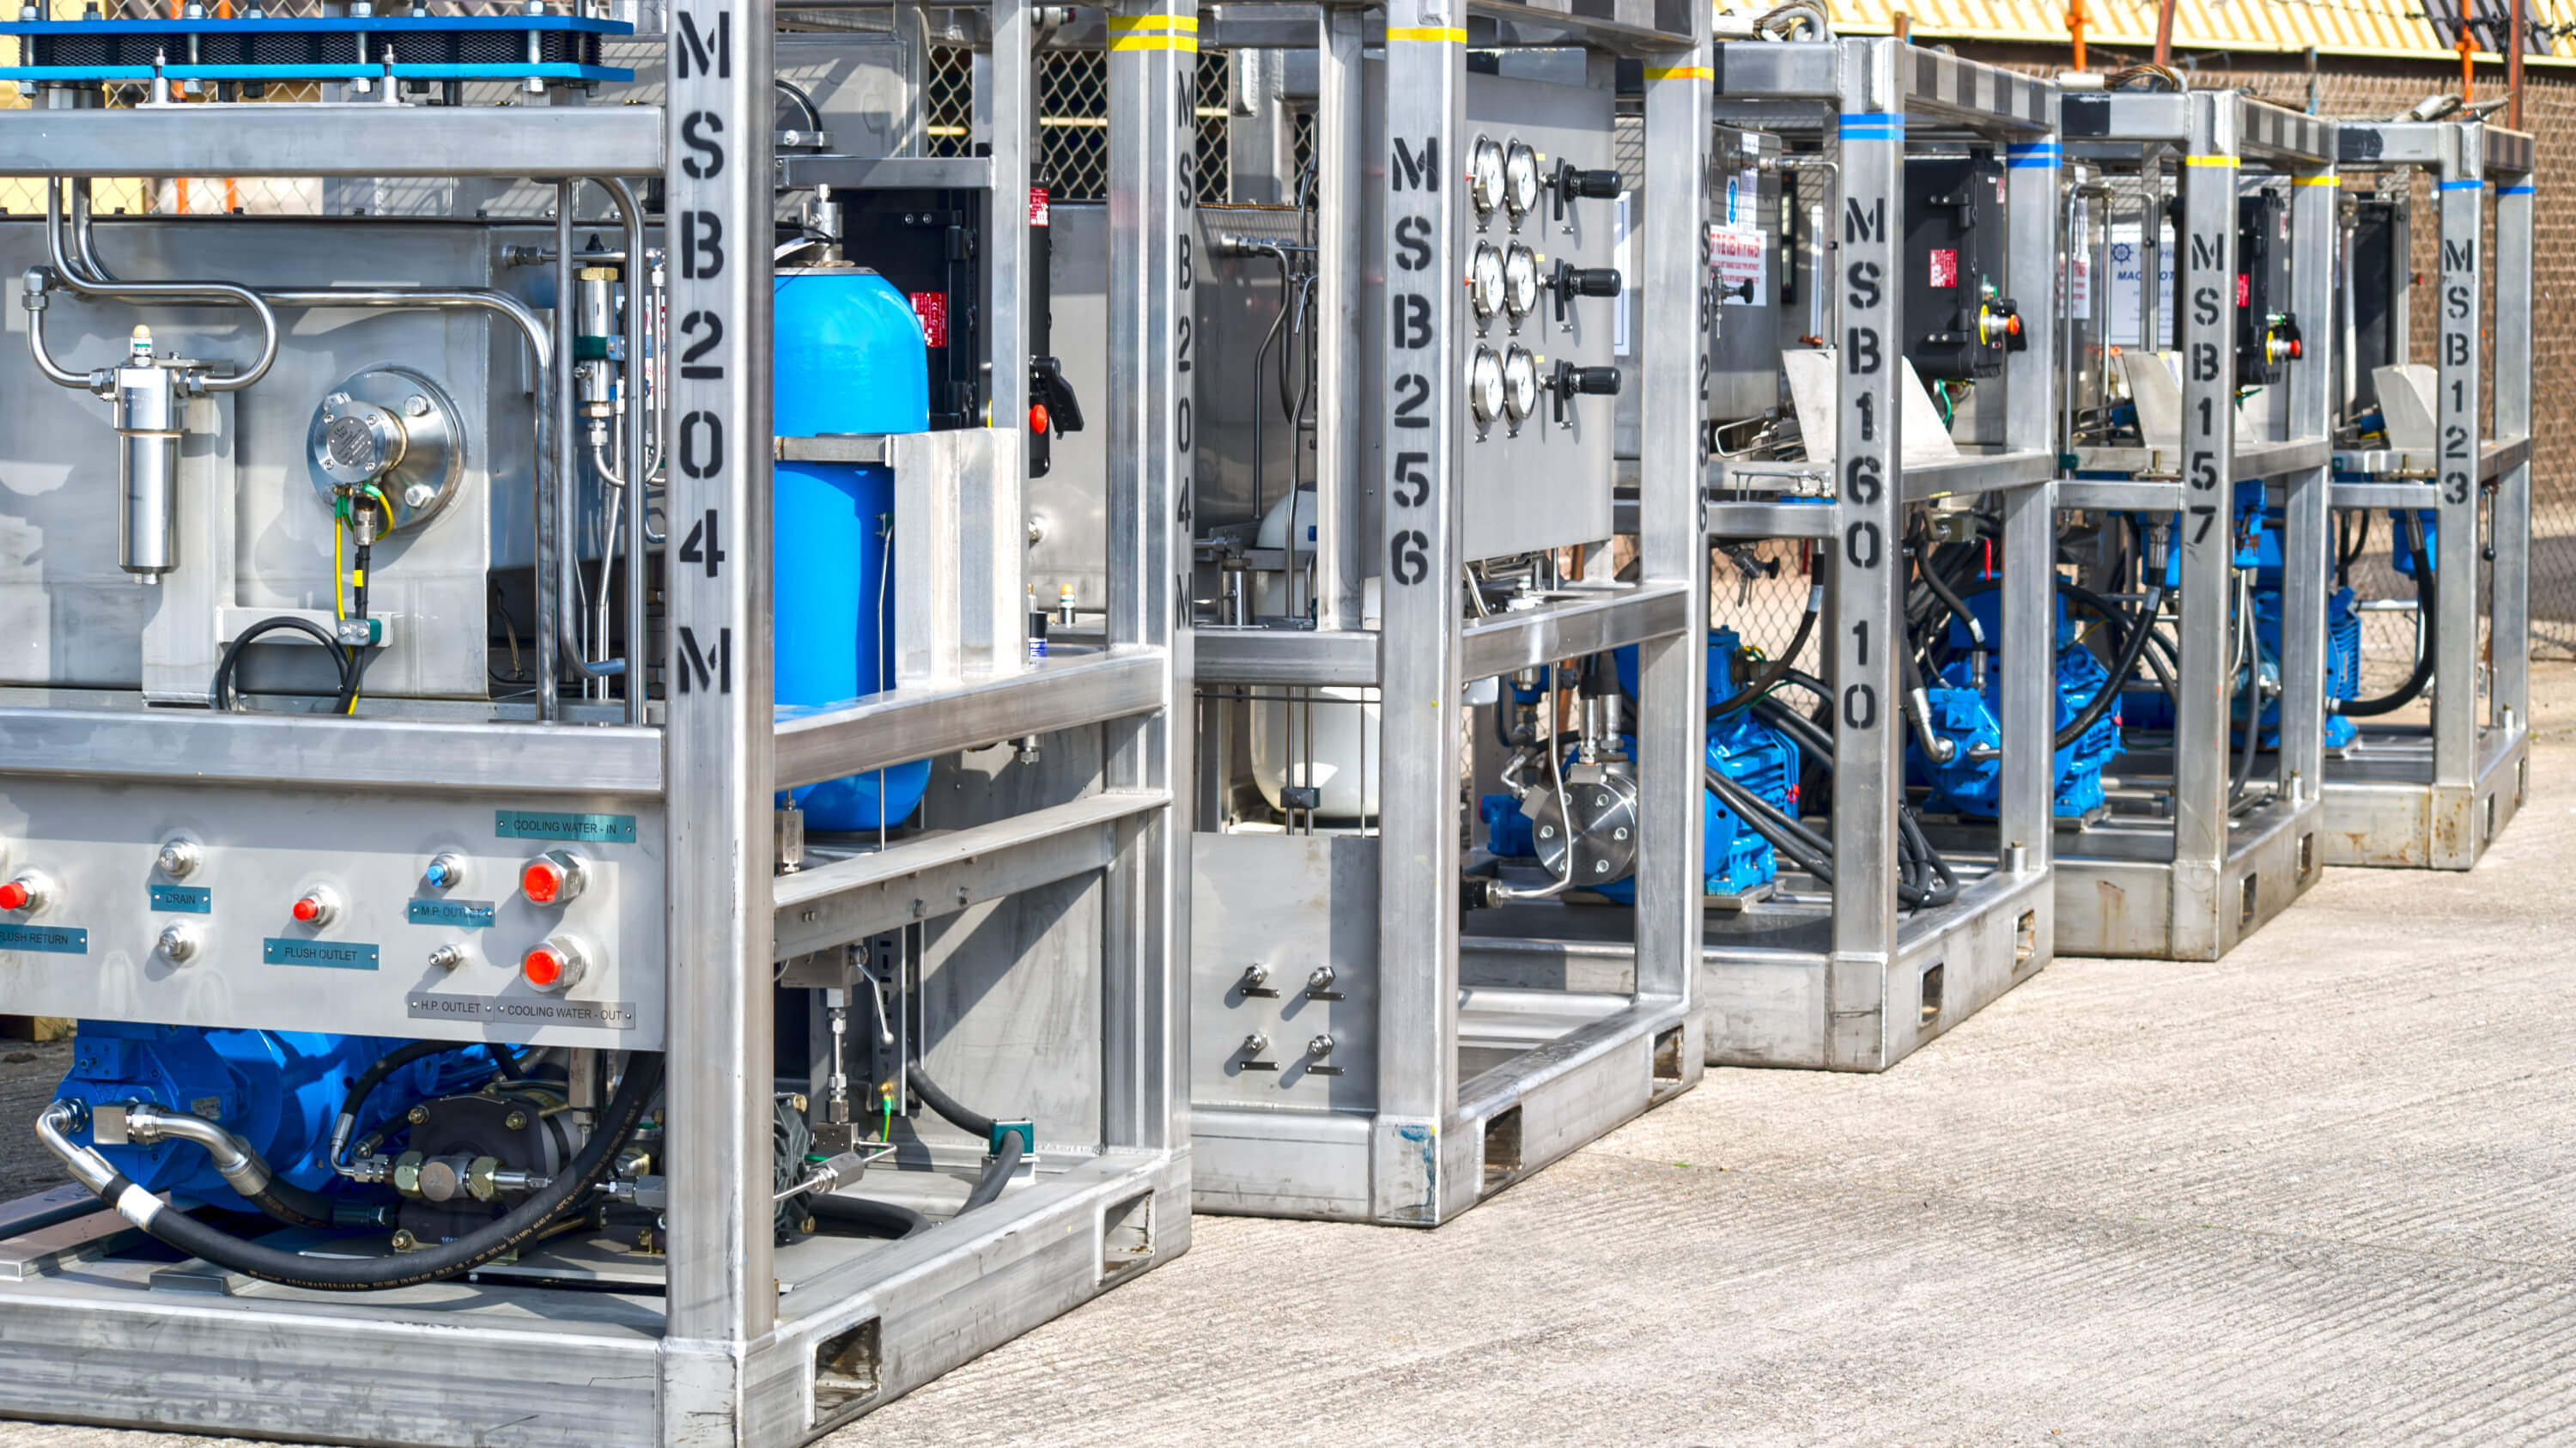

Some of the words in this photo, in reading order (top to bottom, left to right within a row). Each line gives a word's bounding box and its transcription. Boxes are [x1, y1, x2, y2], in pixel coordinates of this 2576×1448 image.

[677, 11, 730, 693] MSB204M
[1391, 137, 1438, 585] MSB256
[2445, 239, 2473, 504] MSB123
[1845, 198, 1885, 569] MSB160
[2190, 234, 2224, 546] MSB157
[1844, 620, 1876, 729] 10
[513, 819, 560, 832] COOLING
[562, 822, 598, 834] WATER
[606, 824, 617, 835] IN
[166, 892, 196, 904] DRAIN
[442, 907, 482, 919] OUTLET
[29, 933, 69, 945] RETURN
[284, 947, 317, 959] FLUSH
[320, 949, 357, 962] OUTLET
[421, 1001, 439, 1012] H.P.
[442, 1002, 481, 1013] OUTLET
[507, 1005, 554, 1019] COOLING
[556, 1007, 592, 1019] WATER
[600, 1009, 623, 1021] OUT
